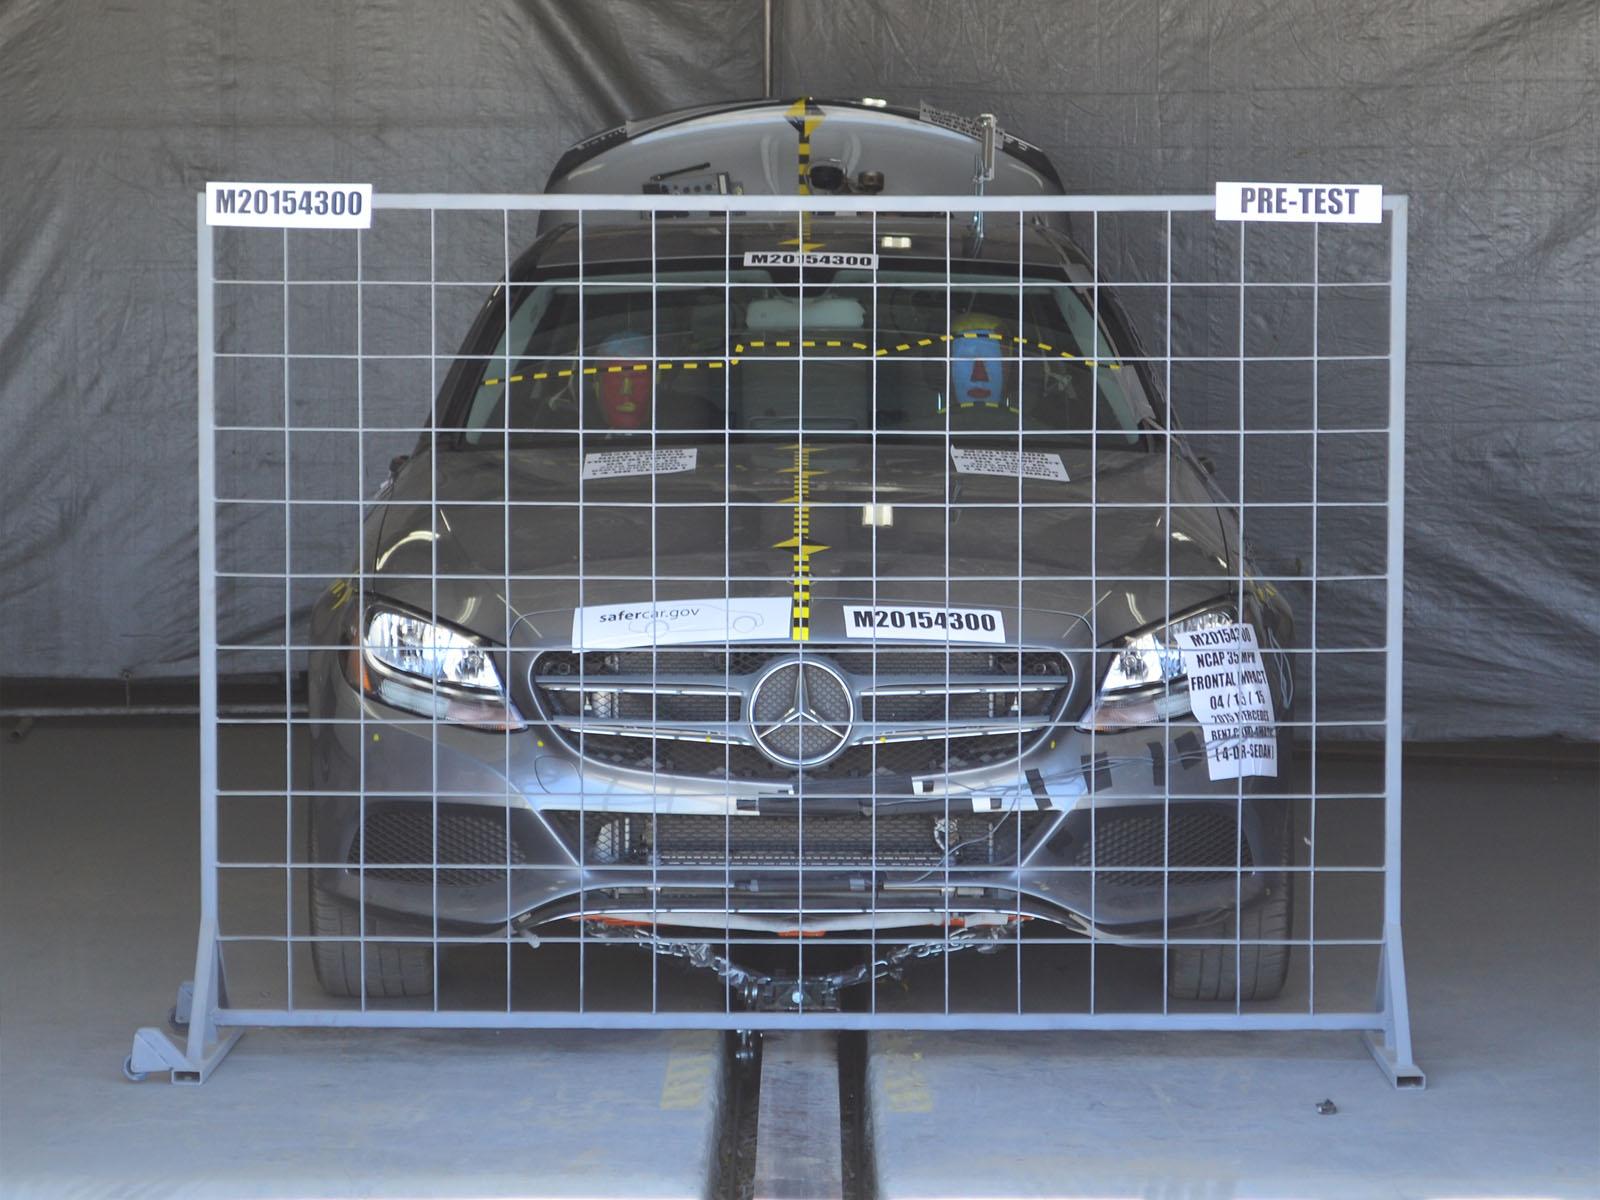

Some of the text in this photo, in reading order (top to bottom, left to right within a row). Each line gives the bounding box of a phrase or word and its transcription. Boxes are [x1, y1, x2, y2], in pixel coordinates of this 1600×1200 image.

[216, 189, 362, 216] M20154300
[1241, 187, 1359, 215] PRE-TEST
[599, 608, 700, 623] safercar.gov
[853, 610, 996, 632] M20154300
[1196, 651, 1225, 668] NCAP
[1227, 651, 1239, 665] 35
[1191, 672, 1236, 691] FRONTAL
[1210, 695, 1224, 710] 04
